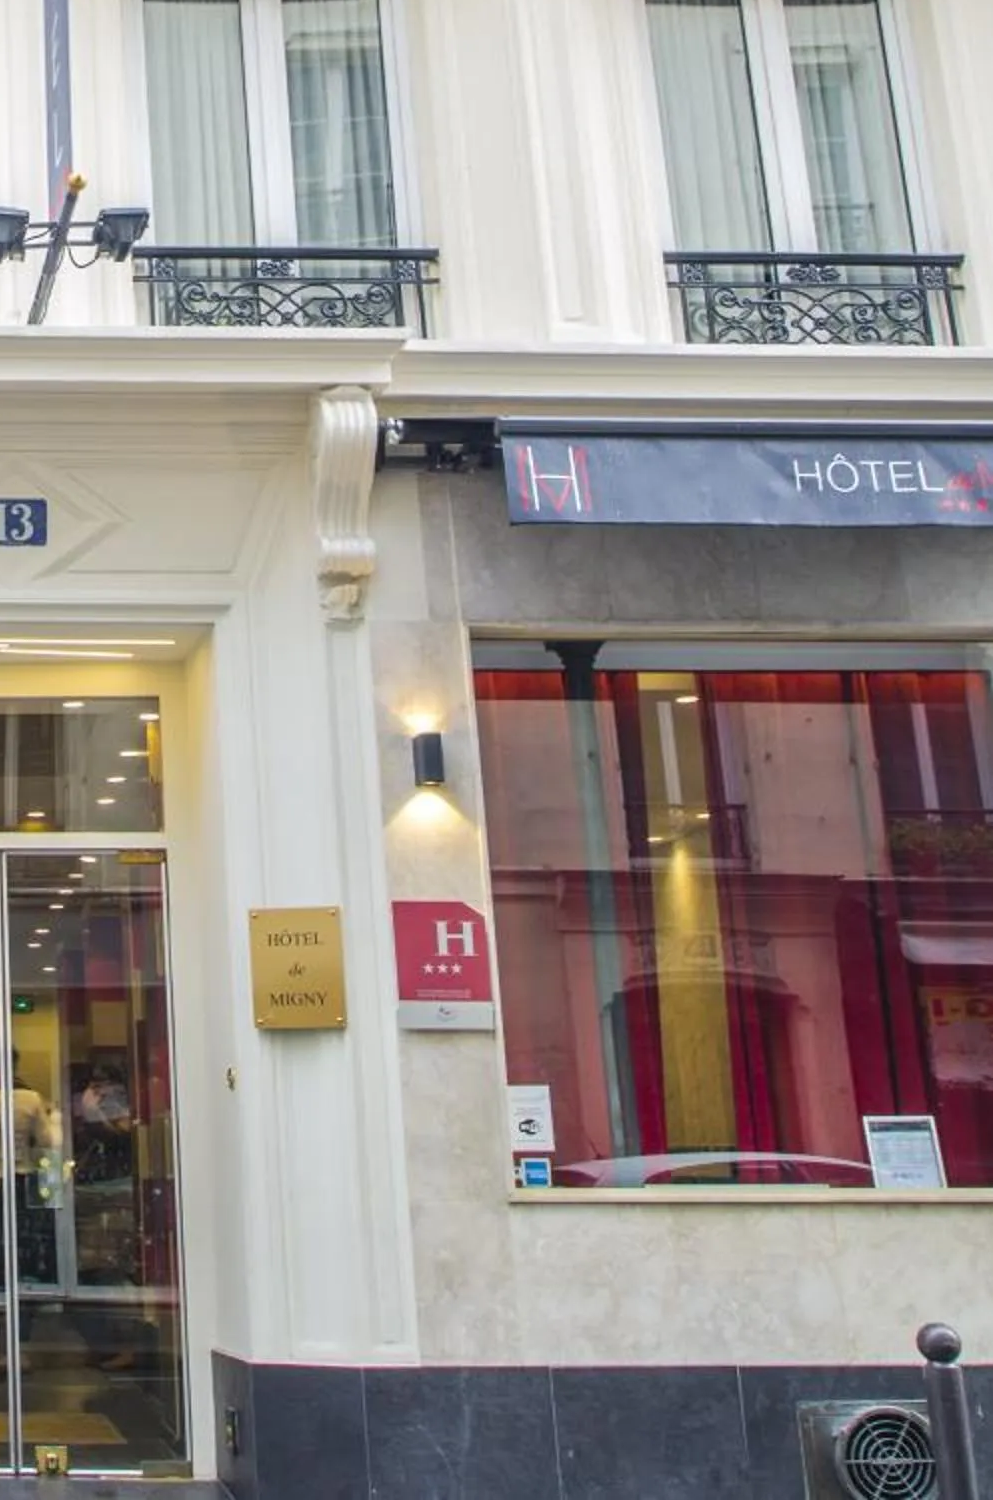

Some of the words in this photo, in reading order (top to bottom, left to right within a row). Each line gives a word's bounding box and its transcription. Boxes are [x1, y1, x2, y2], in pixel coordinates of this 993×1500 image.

[793, 453, 944, 493] HÔTEL
[267, 928, 325, 948] HÔTEL
[431, 919, 480, 957] H
[269, 990, 328, 1008] MIGNY
